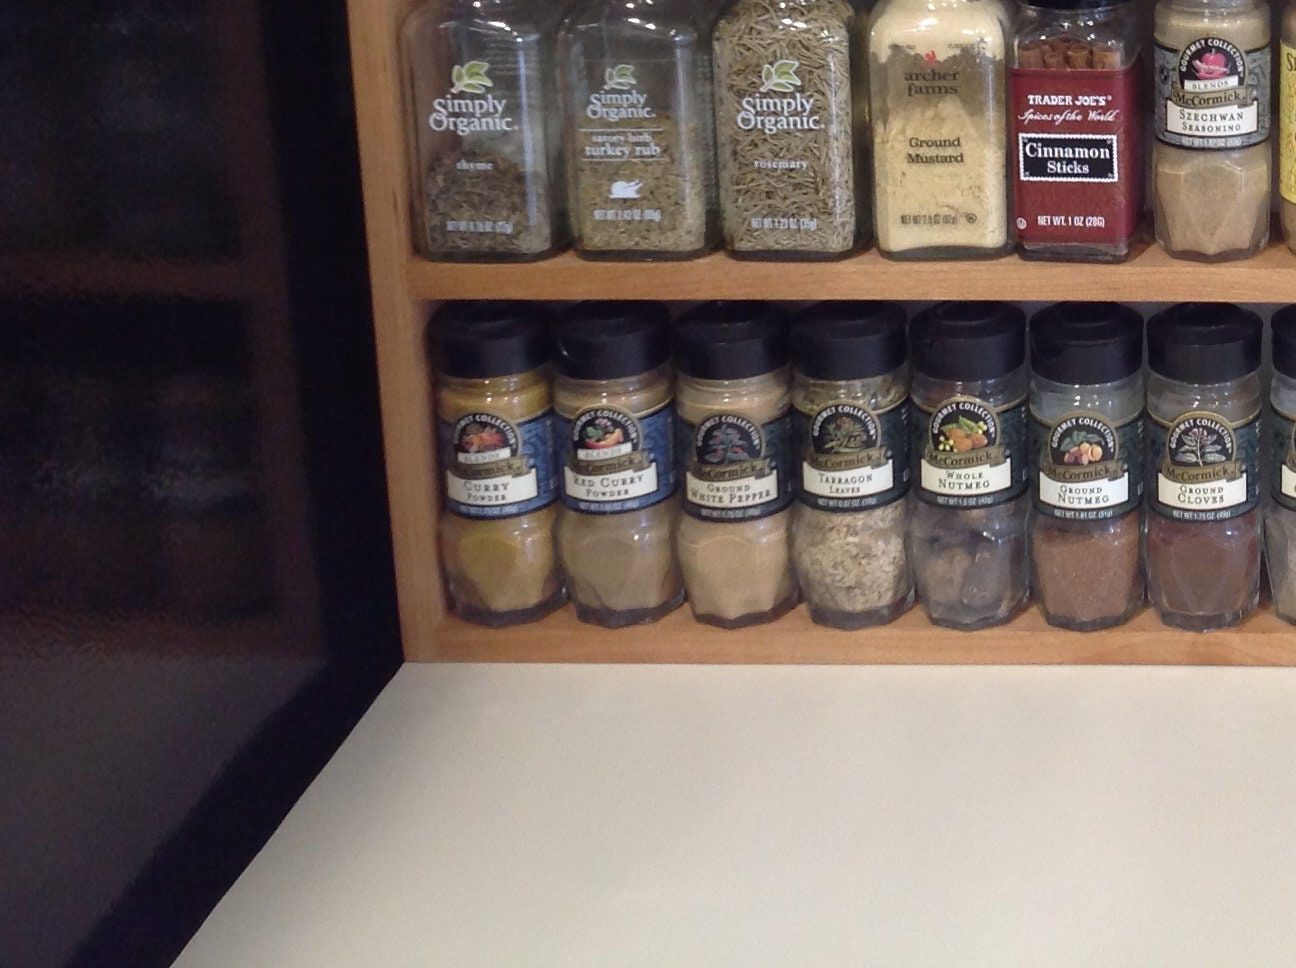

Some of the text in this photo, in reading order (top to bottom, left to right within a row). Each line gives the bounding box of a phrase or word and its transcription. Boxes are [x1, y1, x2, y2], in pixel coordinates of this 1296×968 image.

[1181, 38, 1243, 73] GOURMET COLLECTION
[904, 71, 960, 82] archer
[907, 83, 958, 97] farms
[1192, 80, 1229, 90] BLENDS
[433, 95, 507, 117] Simply
[590, 91, 647, 110] Simply
[742, 94, 813, 115] Simply
[1027, 95, 1107, 107] TRADER JOE'S
[586, 104, 652, 122] Organic
[1087, 109, 1119, 122] World
[1179, 109, 1244, 122] SZECHWAN
[429, 113, 513, 135] Organic
[737, 112, 820, 134] Organic
[1182, 121, 1241, 132] SEASONING
[909, 137, 961, 148] Ground
[586, 144, 660, 160] turkey rub
[1025, 143, 1110, 160] Cinnamon
[754, 159, 808, 171] rosemary
[906, 153, 963, 164] Mustard
[1047, 161, 1089, 175] Sticks
[1038, 216, 1084, 226] NET OZ
[959, 402, 995, 436] COLLECTION
[1078, 417, 1114, 451] COLLECTION
[1196, 418, 1231, 451] COLLECTION
[600, 474, 643, 488] CURRY
[818, 473, 873, 485] TARRAGON
[945, 471, 983, 480] WHOLE
[463, 481, 509, 492] CURRY
[938, 479, 990, 490] NUTMEG
[1060, 485, 1102, 495] GROUND
[1180, 486, 1224, 495] GROUND
[1057, 494, 1109, 505] NUTMEG
[1178, 494, 1225, 505] CLOVES
